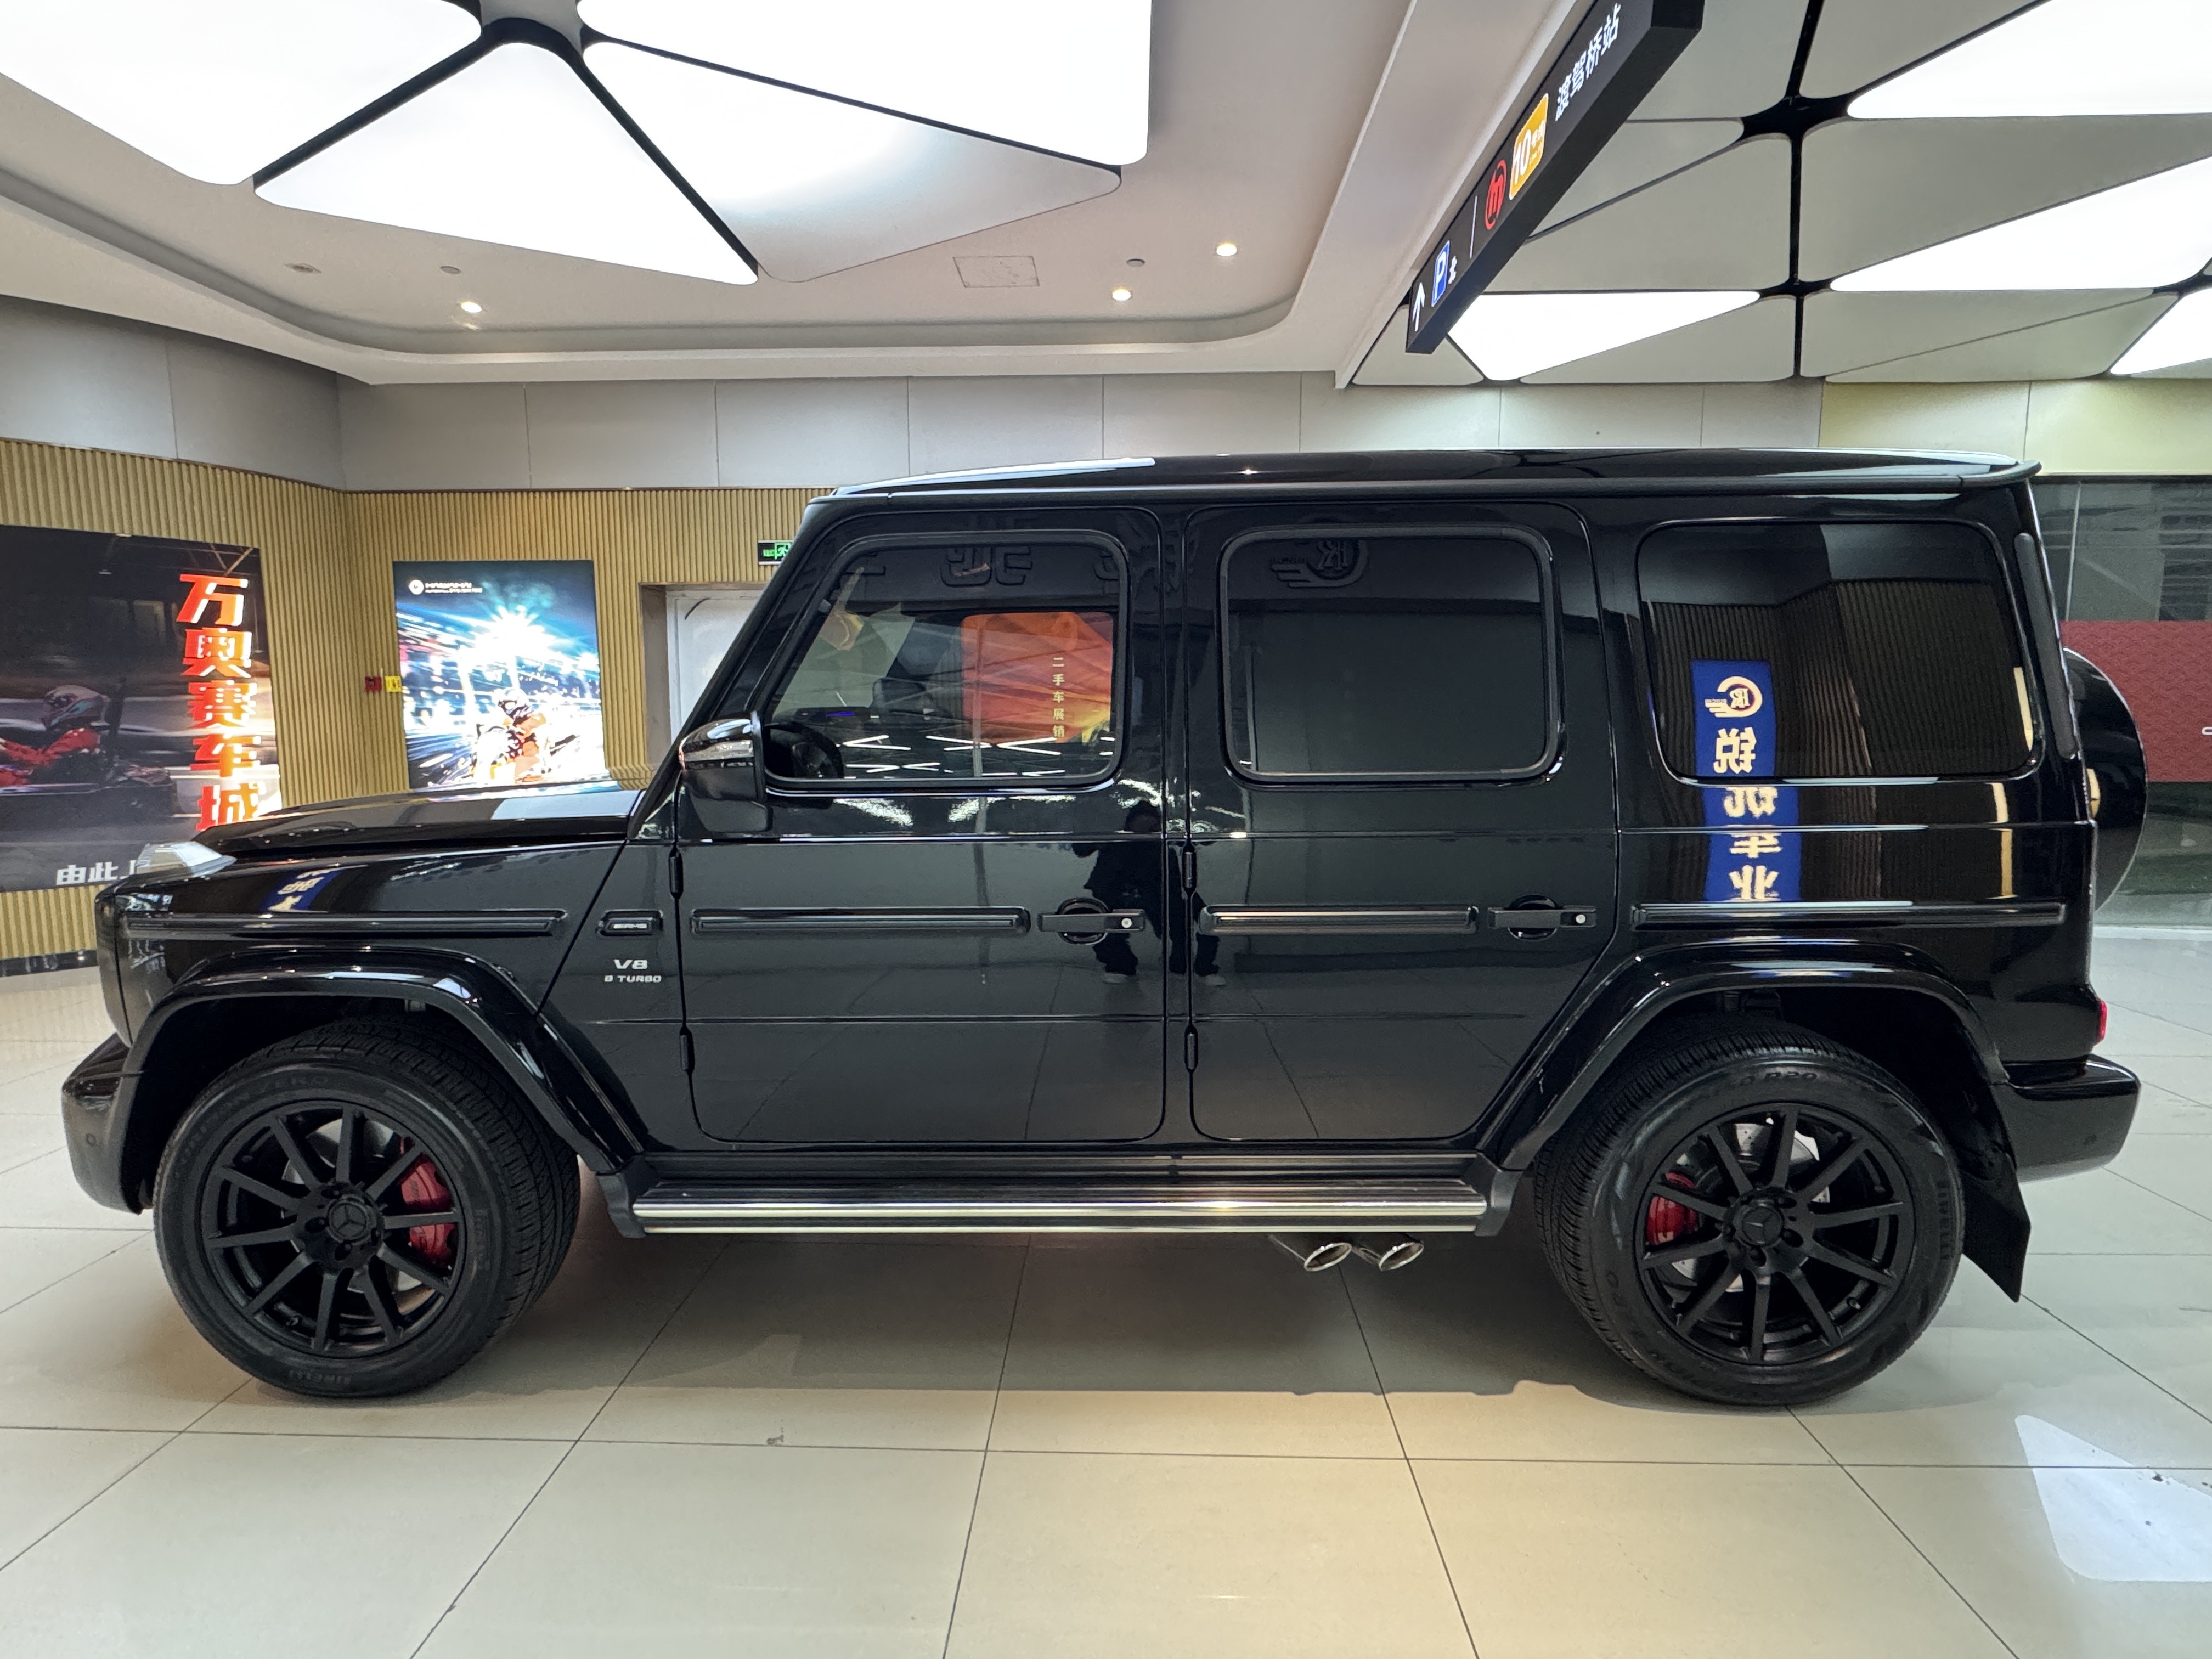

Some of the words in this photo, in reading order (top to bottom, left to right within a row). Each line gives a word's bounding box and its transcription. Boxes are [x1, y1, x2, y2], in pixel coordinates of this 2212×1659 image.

[1514, 129, 1532, 185] 10
[1434, 251, 1447, 300] P
[1052, 657, 1065, 737] 二手车展销
[613, 959, 648, 969] V8
